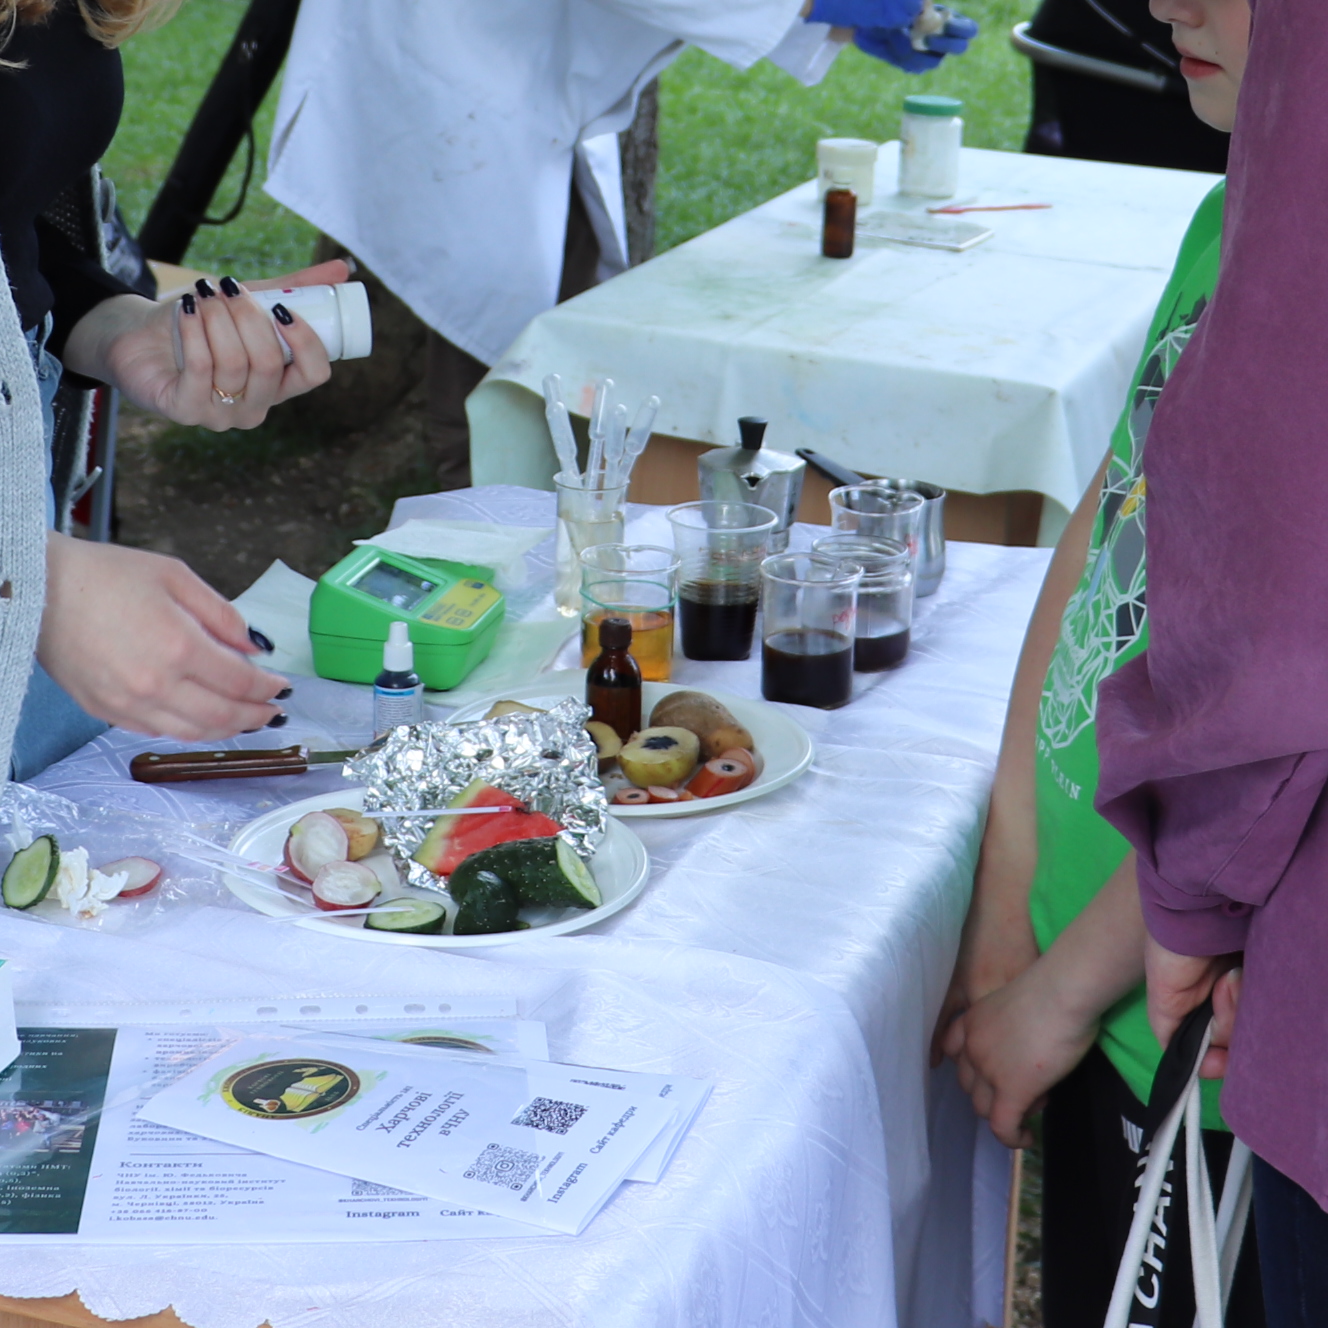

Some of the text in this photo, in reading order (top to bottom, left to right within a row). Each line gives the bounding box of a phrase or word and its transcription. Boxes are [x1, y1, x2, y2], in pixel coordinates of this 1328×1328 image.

[375, 1091, 433, 1134] Харчові
[396, 1091, 465, 1148] технології
[589, 1105, 638, 1154] Сайт кафедри
[119, 1161, 204, 1169] Контакти
[546, 1162, 589, 1204] Instagram
[346, 1210, 420, 1220] Instagram
[440, 1209, 474, 1217] Сайт
